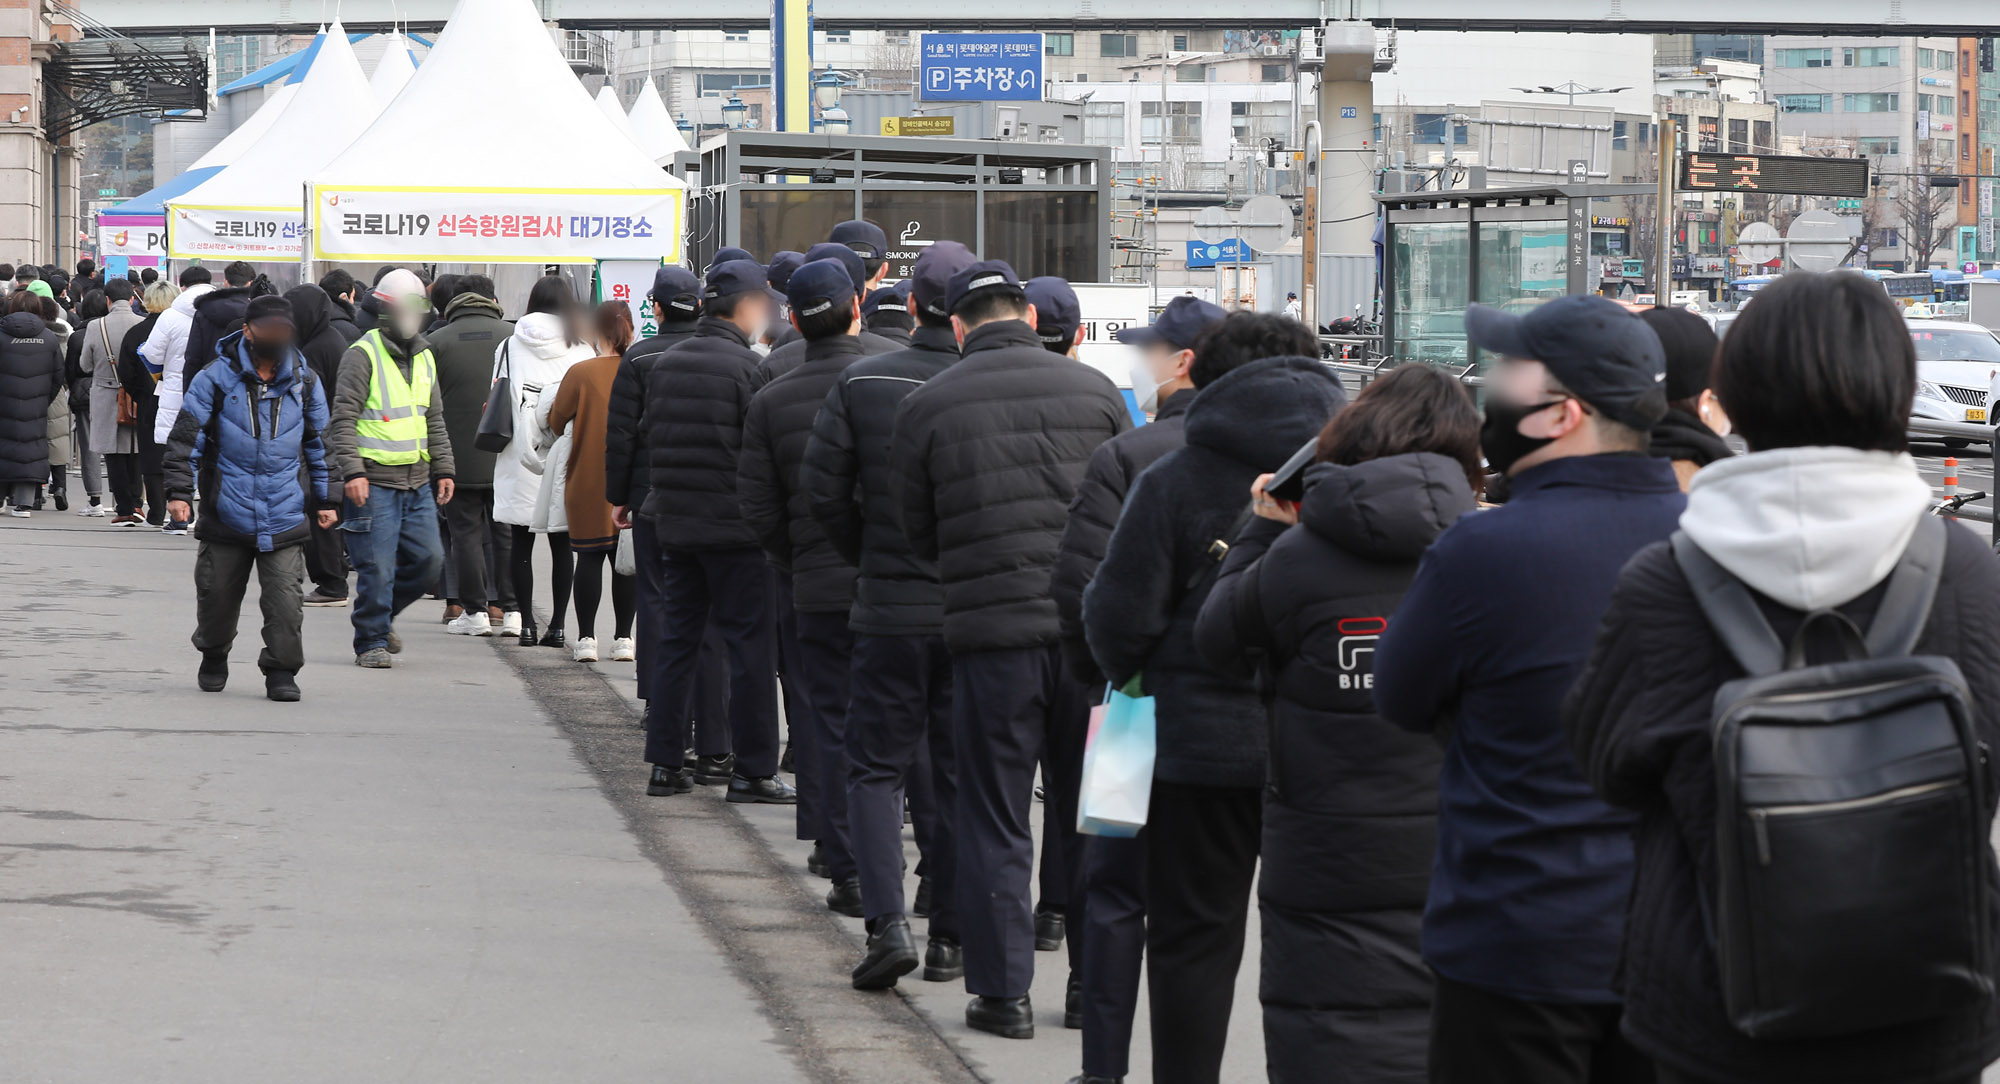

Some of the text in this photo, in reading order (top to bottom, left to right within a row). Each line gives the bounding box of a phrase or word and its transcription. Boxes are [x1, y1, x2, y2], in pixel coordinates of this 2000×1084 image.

[926, 43, 1037, 54] 서울역 롯데아울렛 롯데마트
[953, 67, 1015, 92] 주차장
[1341, 108, 1356, 116] P13
[1689, 154, 1761, 189] 는 곳
[214, 221, 277, 237] 코로나19
[342, 213, 653, 239] 코로나19 신속항원검사 대기장소
